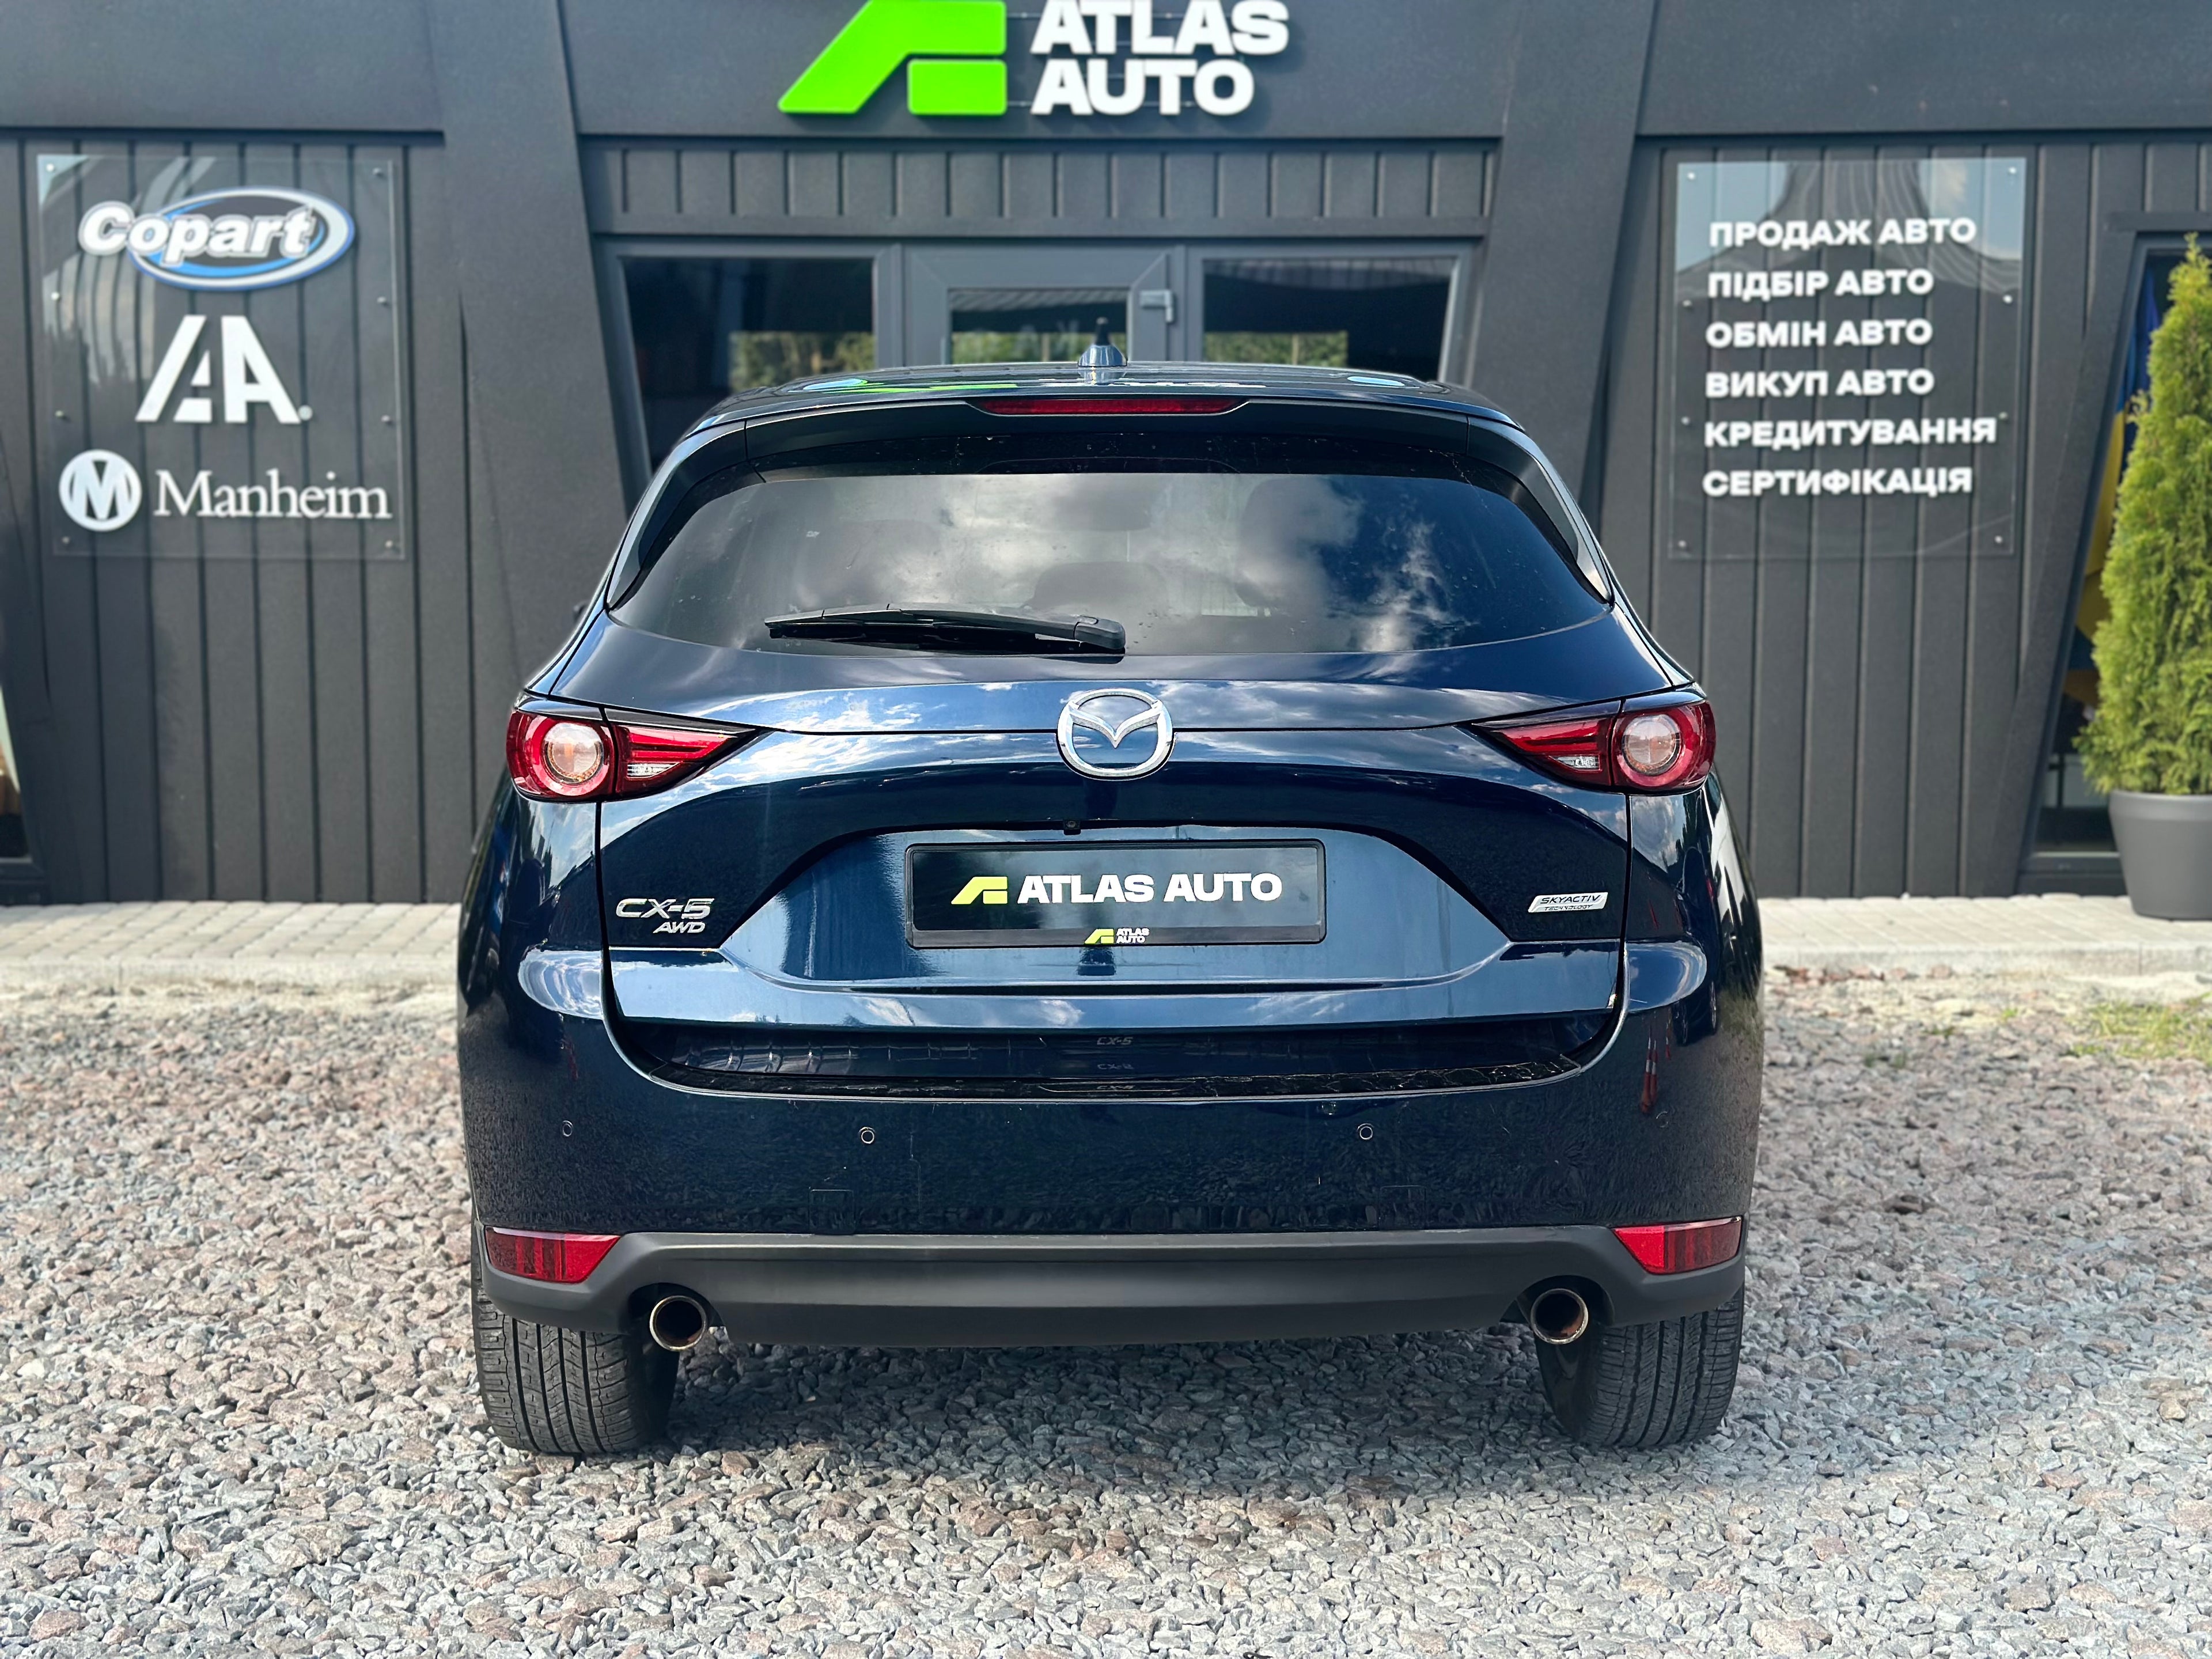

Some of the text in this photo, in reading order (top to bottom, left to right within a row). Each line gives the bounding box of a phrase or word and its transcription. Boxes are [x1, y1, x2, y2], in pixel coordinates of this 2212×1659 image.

[1031, 0, 1289, 55] ATLAS
[1031, 59, 1255, 115] AUTO
[79, 201, 316, 266] Copart
[1710, 218, 1976, 250] ПРОДАЖ АВТО
[1708, 268, 1934, 302] ПІДБІР АВТО
[1706, 319, 1933, 348] ОБМІН АВТО
[1706, 369, 1934, 397] ВИКУП АВТО
[1705, 418, 1997, 450] КРЕДИТУВАННЯ
[154, 468, 392, 518] Manheim
[1703, 467, 1972, 497] СЕРТИФІКАЦІЯ
[1017, 873, 1282, 904] ATLAS AUTO
[1540, 895, 1601, 904] SKYACTIV
[616, 898, 715, 919] CX-5
[653, 922, 706, 934] AWD
[1116, 927, 1150, 936] ATLAS
[1116, 935, 1146, 944] AUTO
